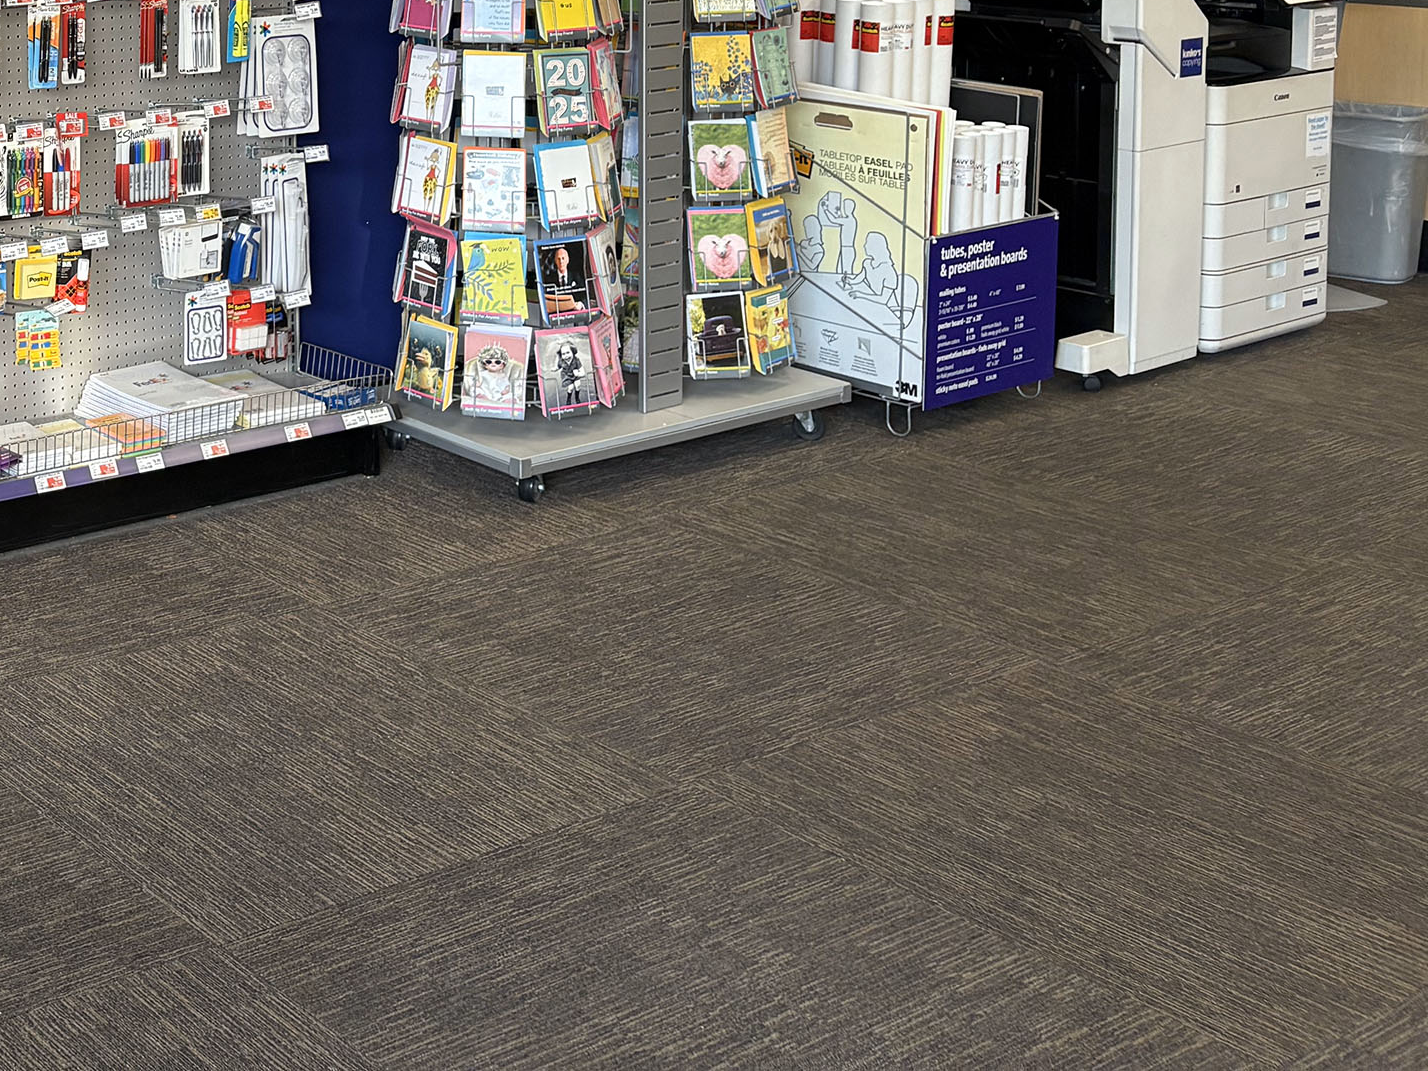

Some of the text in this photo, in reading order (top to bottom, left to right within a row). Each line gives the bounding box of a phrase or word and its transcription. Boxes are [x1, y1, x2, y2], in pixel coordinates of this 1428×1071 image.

[546, 58, 586, 87] 20
[1182, 57, 1201, 67] copying
[1274, 93, 1290, 101] Canon
[547, 97, 588, 123] 25
[123, 128, 155, 143] Sharpie
[819, 159, 857, 173] TABLEAU
[858, 164, 865, 175] À
[867, 167, 911, 182] FEUILLES
[820, 149, 862, 163] TABLETOP
[864, 156, 894, 169] EASEL
[896, 161, 914, 172] PAD
[818, 169, 906, 190] MOBILES SUR TABLE
[941, 239, 995, 261] tubes, poster
[940, 247, 1028, 279] & presentation boards
[29, 275, 49, 283] Post-it
[895, 380, 918, 397] 3M
